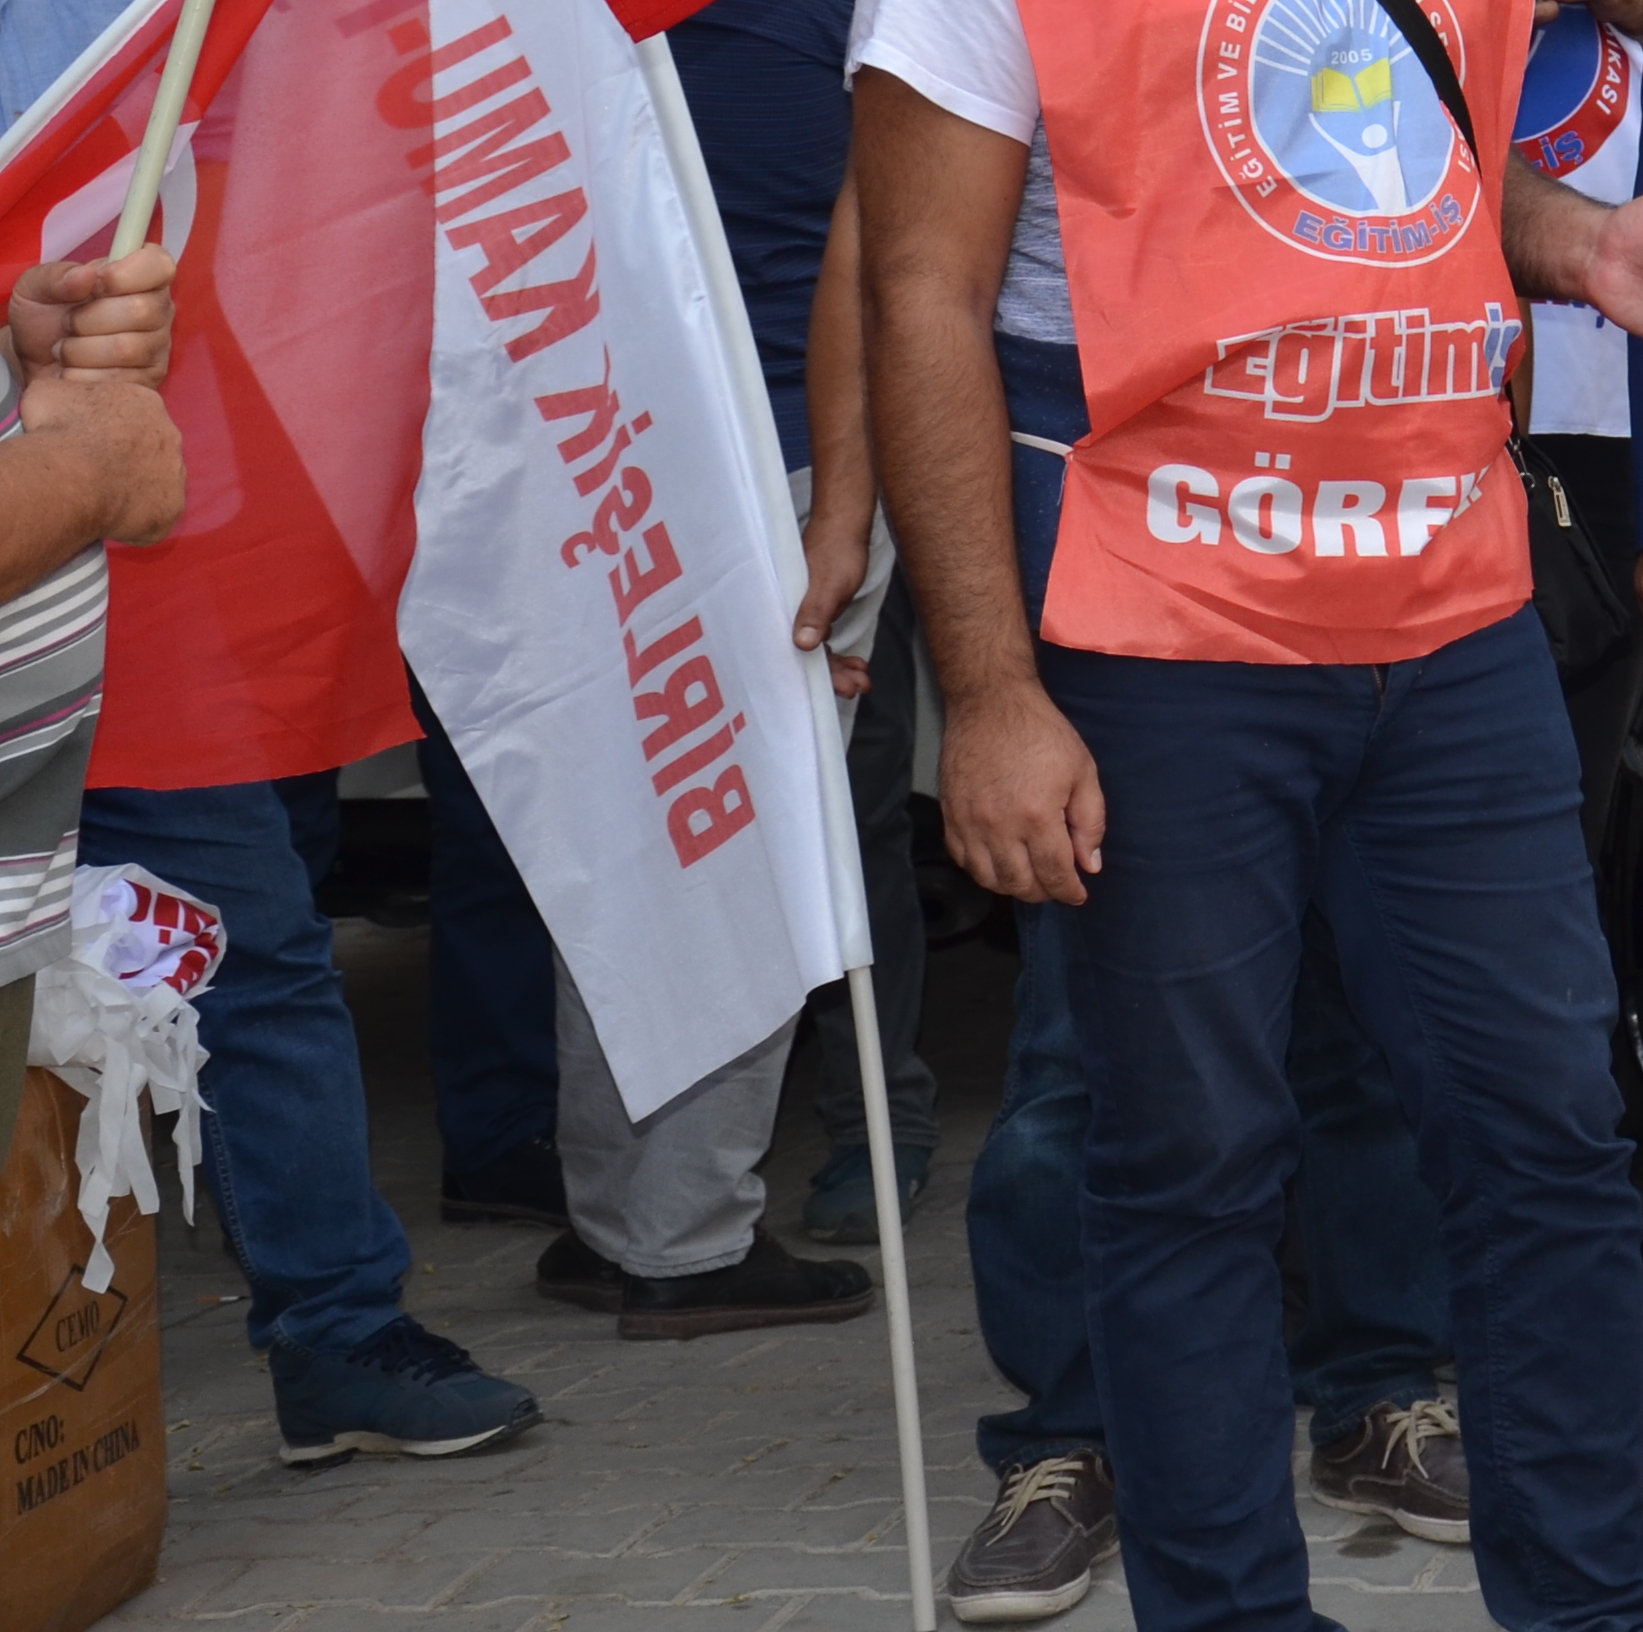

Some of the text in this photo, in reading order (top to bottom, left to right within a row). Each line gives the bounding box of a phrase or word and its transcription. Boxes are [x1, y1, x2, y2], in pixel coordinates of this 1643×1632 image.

[1217, 40, 1241, 80] VE
[1331, 48, 1373, 66] 2005
[1217, 91, 1278, 198] EĞİTİM
[1293, 193, 1465, 254] EĞİTİM-İŞ
[55, 1300, 101, 1353] CEMO
[14, 1414, 65, 1466] C/NO:
[16, 1418, 141, 1516] MADE IN CHINA
